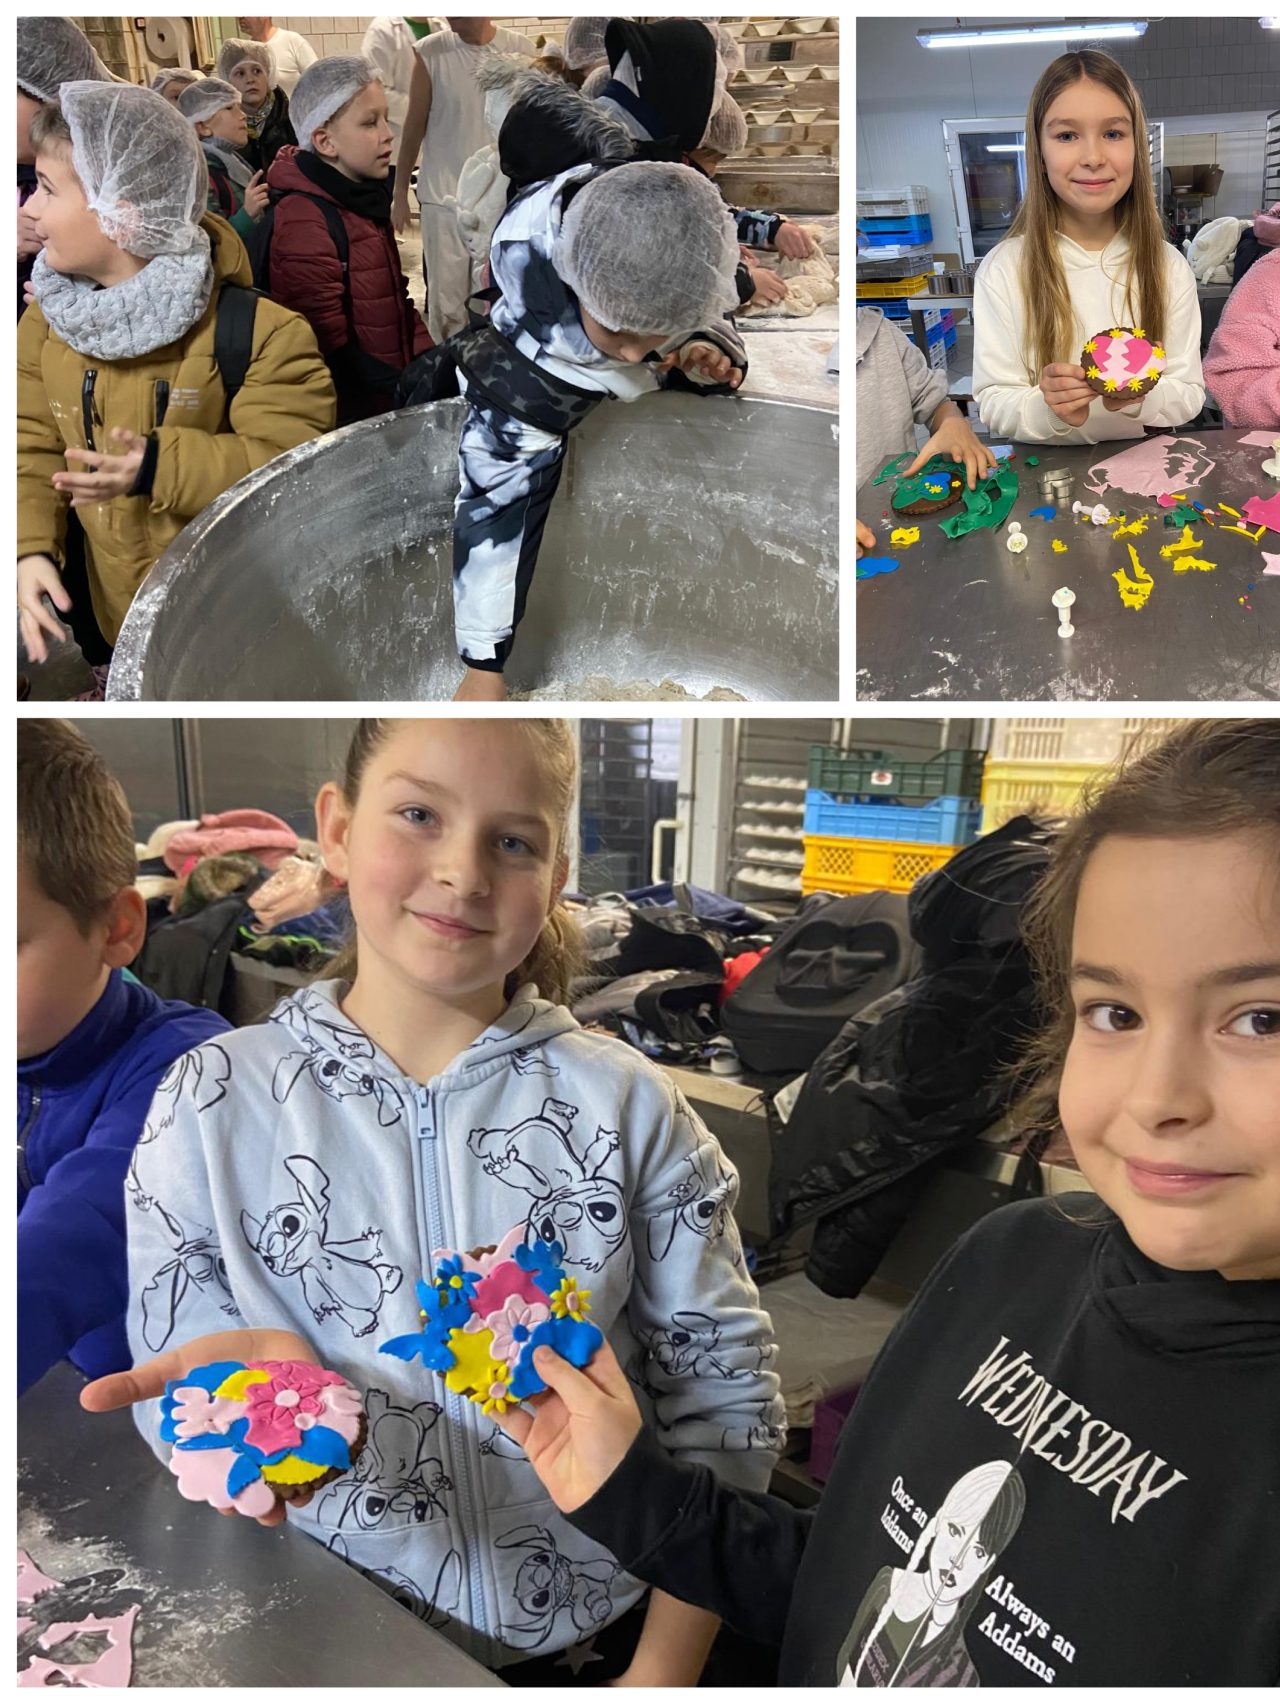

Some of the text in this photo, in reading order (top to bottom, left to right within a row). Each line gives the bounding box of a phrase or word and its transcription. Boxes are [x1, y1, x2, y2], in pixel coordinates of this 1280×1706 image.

[958, 1335, 1188, 1524] WEDNESDAY
[891, 1475, 928, 1528] Once an
[978, 1612, 1056, 1684] Addams
[985, 1575, 1076, 1664] Always an
